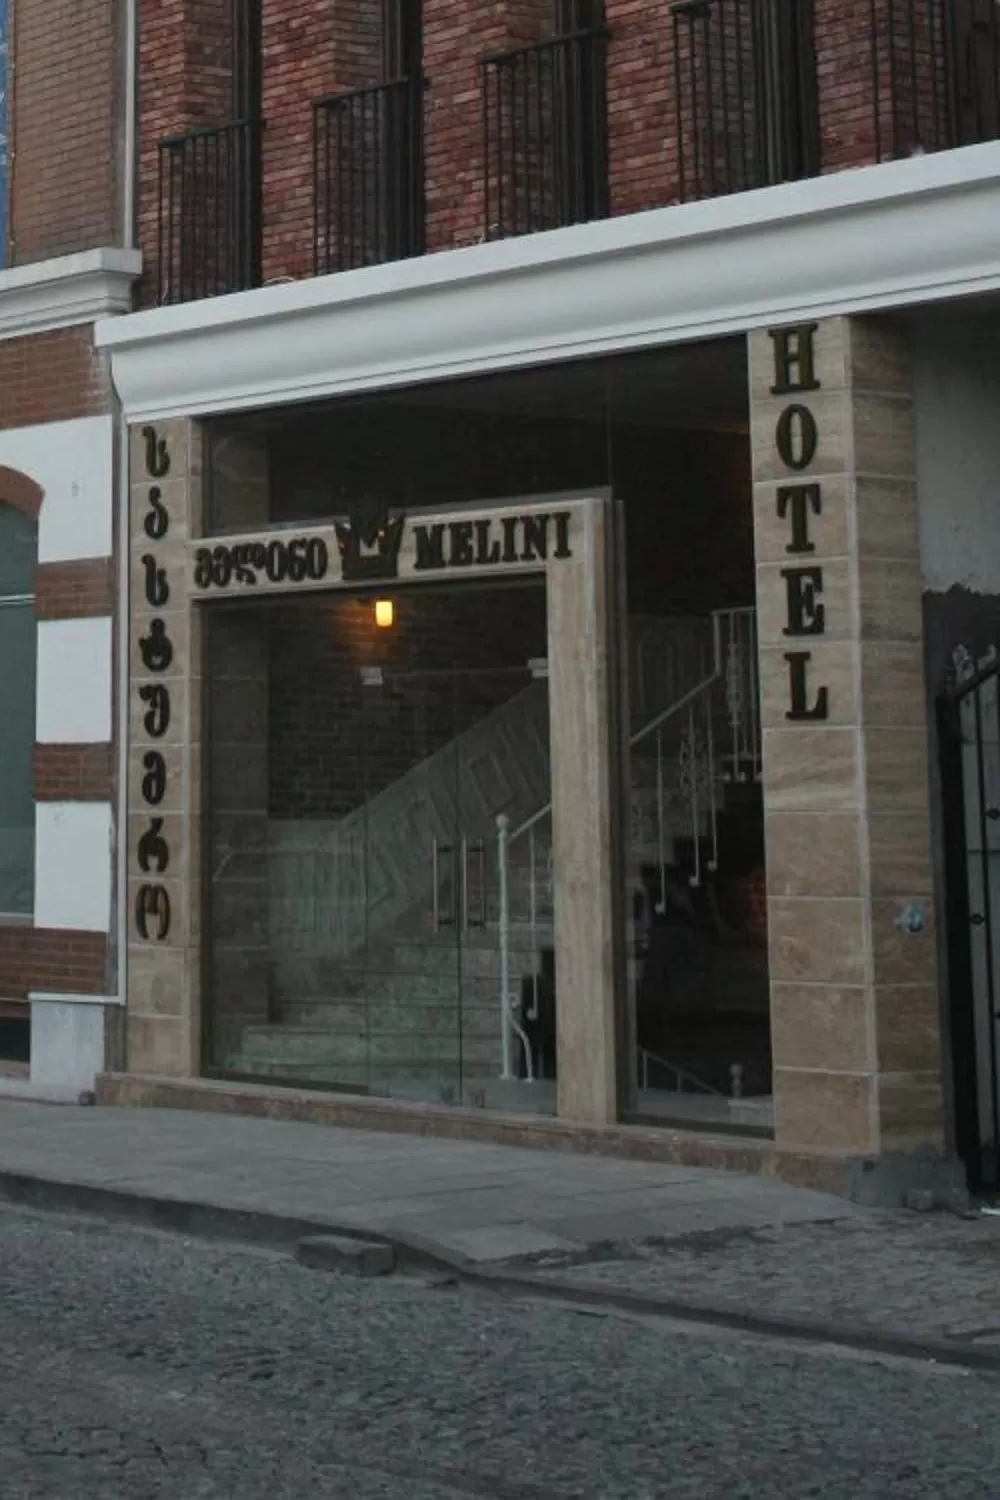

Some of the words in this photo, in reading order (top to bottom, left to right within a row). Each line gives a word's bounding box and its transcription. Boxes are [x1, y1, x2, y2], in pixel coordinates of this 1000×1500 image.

[195, 538, 328, 588] მელინი
[413, 511, 572, 570] MELINI
[768, 322, 829, 721] HOTEL
[136, 425, 173, 940] სასტუმრო
